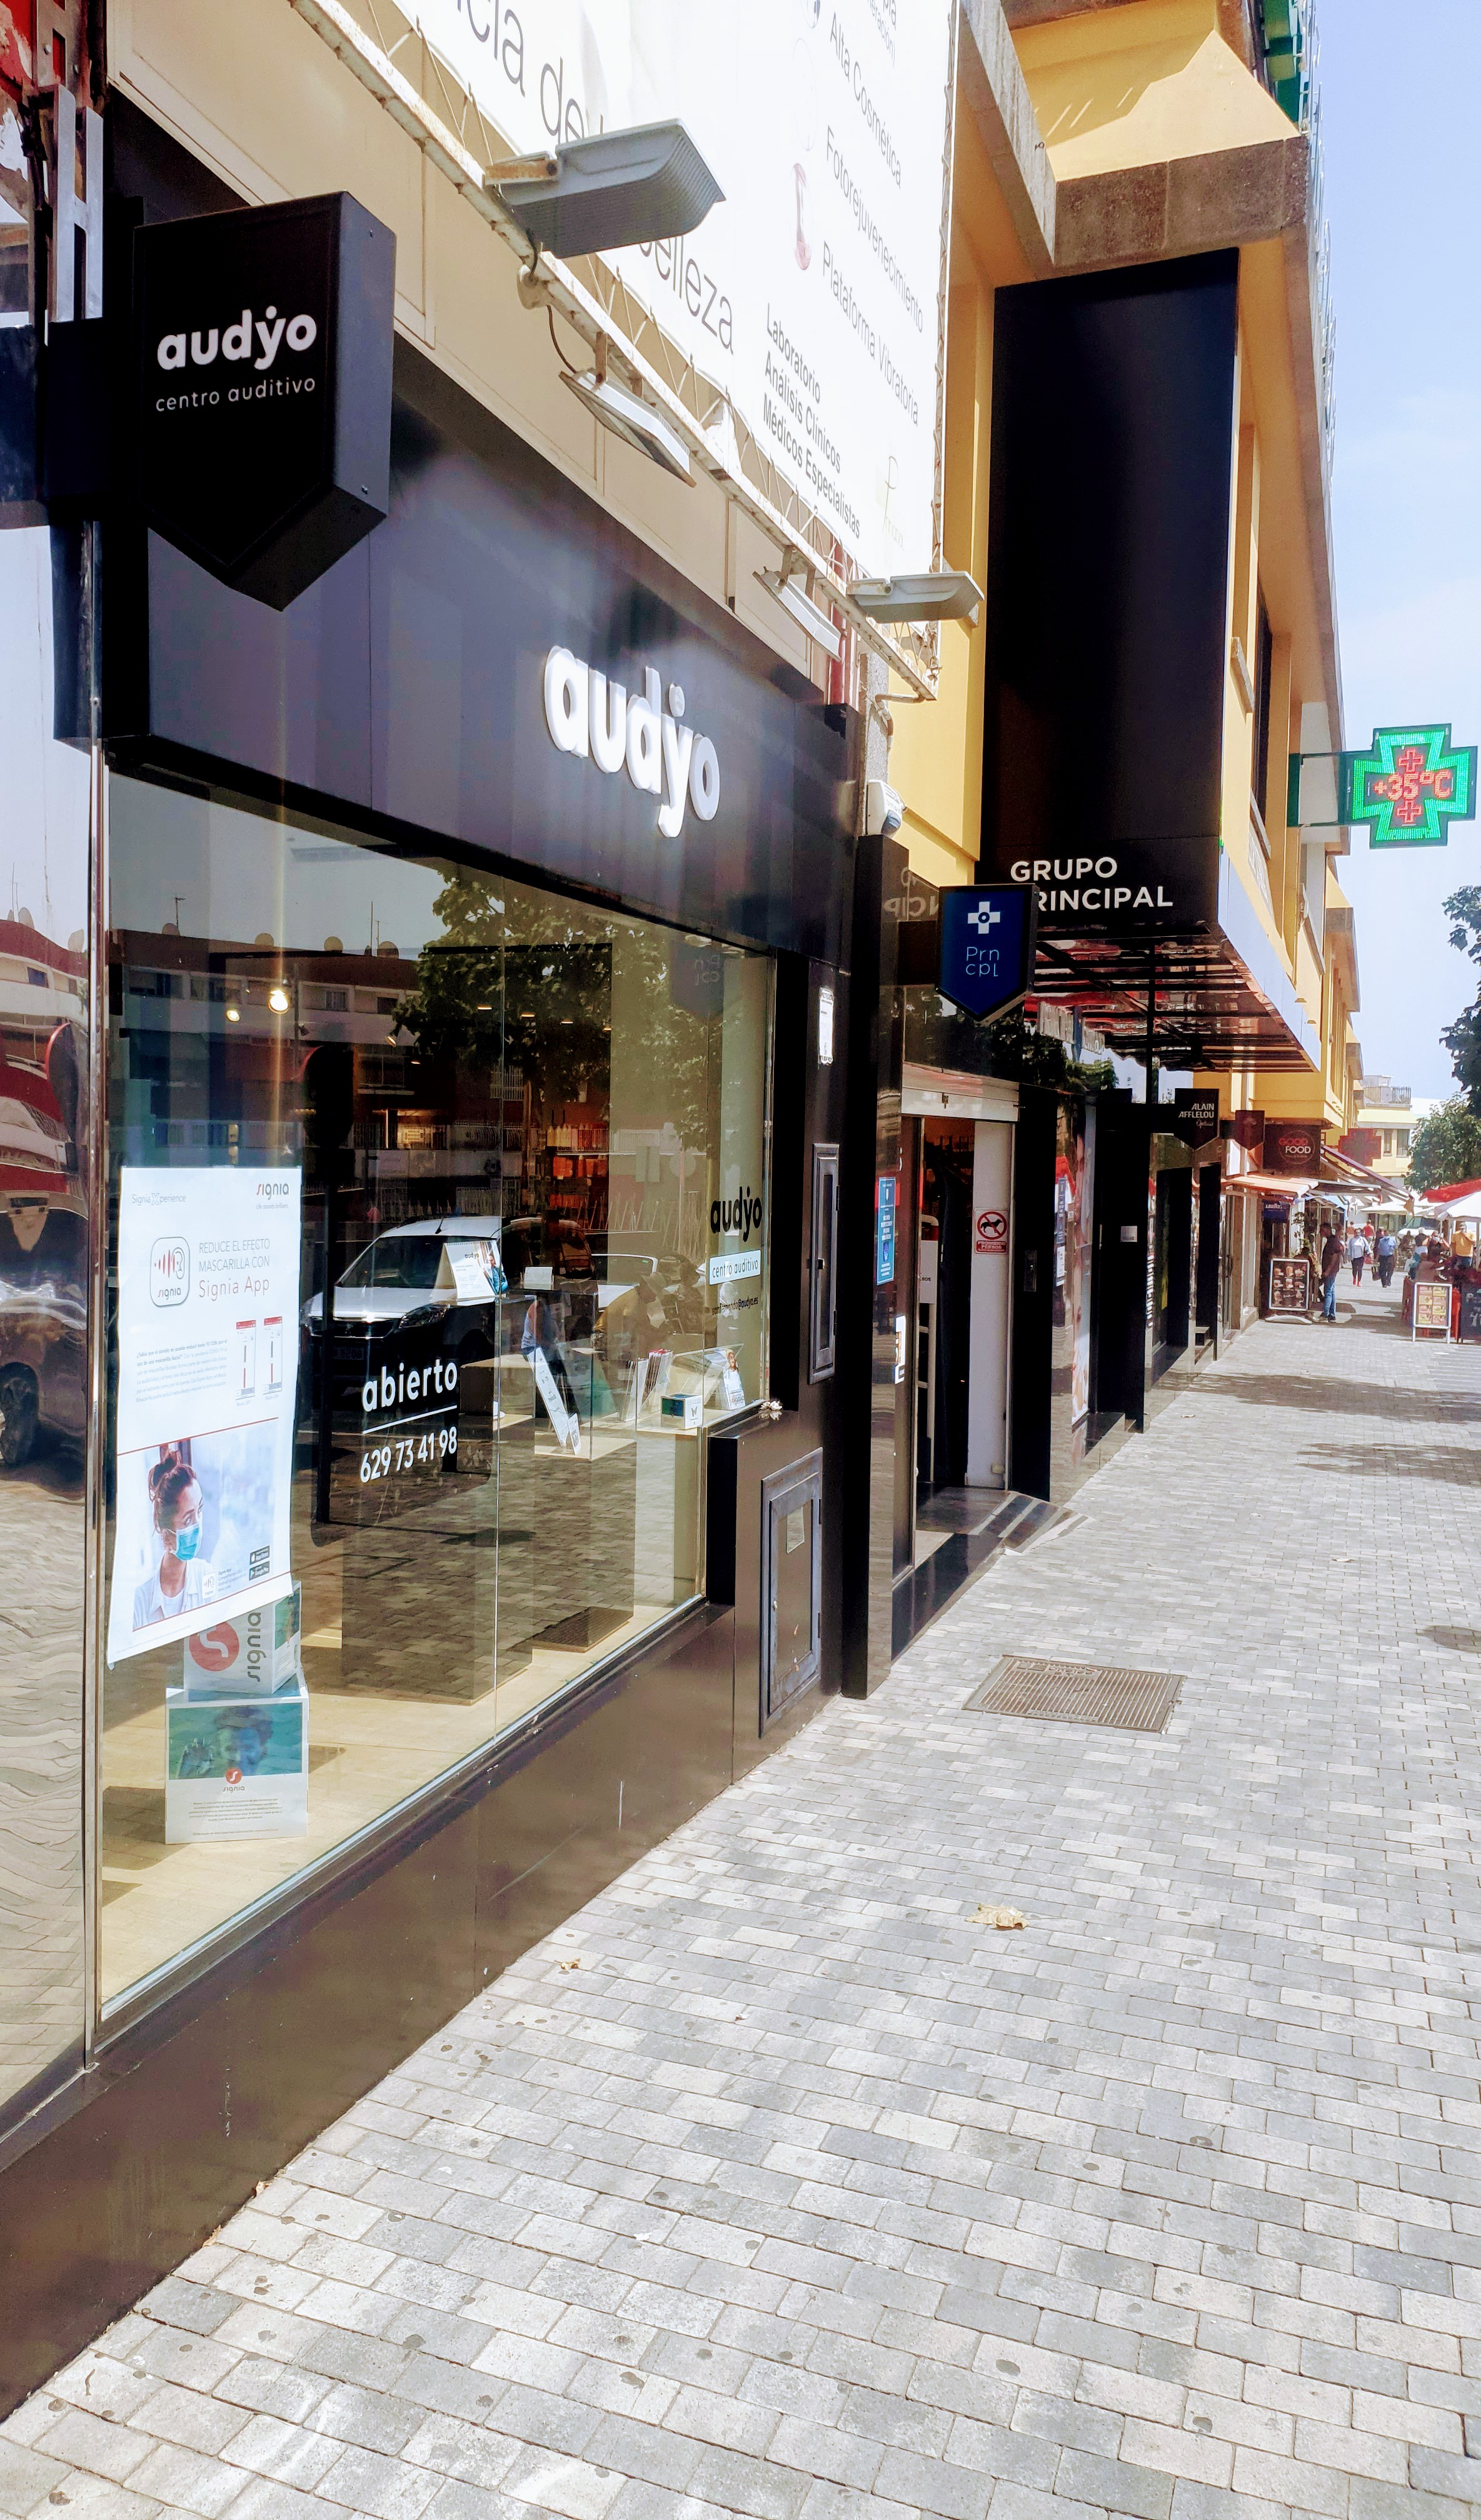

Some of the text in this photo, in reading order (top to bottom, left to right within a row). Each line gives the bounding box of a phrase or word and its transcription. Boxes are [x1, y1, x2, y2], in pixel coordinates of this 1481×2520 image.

[830, 11, 901, 189] Alta Cosmética
[826, 125, 923, 333] Fotorejuvenecimiento
[638, 236, 734, 355] elleza
[158, 306, 317, 370] audyo
[767, 302, 821, 404] Laboratorio
[823, 241, 876, 360] Plataforma
[878, 335, 919, 427] Vibratoria
[156, 376, 315, 412] centro auditivo
[765, 351, 841, 474] Análisis Clínicos
[763, 392, 861, 539] Médicos Especialistas
[544, 646, 720, 838] audyo
[1010, 856, 1118, 882] GRUPO
[1038, 886, 1173, 911] RINCIPAL
[966, 946, 1000, 961] Prn
[1285, 1146, 1312, 1154] FOOD
[256, 1183, 289, 1200] signia
[710, 1186, 763, 1242] audyo
[199, 1238, 270, 1254] REDUCE EL EFECTO
[199, 1256, 270, 1272] MASCARILLA CON
[712, 1258, 758, 1278] centro auditivo
[158, 1287, 182, 1301] signia
[199, 1276, 270, 1301] Signia App
[362, 1359, 458, 1412] abierto
[360, 1426, 458, 1484] 629 73 41 98
[247, 1612, 267, 1682] signia
[223, 1786, 245, 1794] signia
